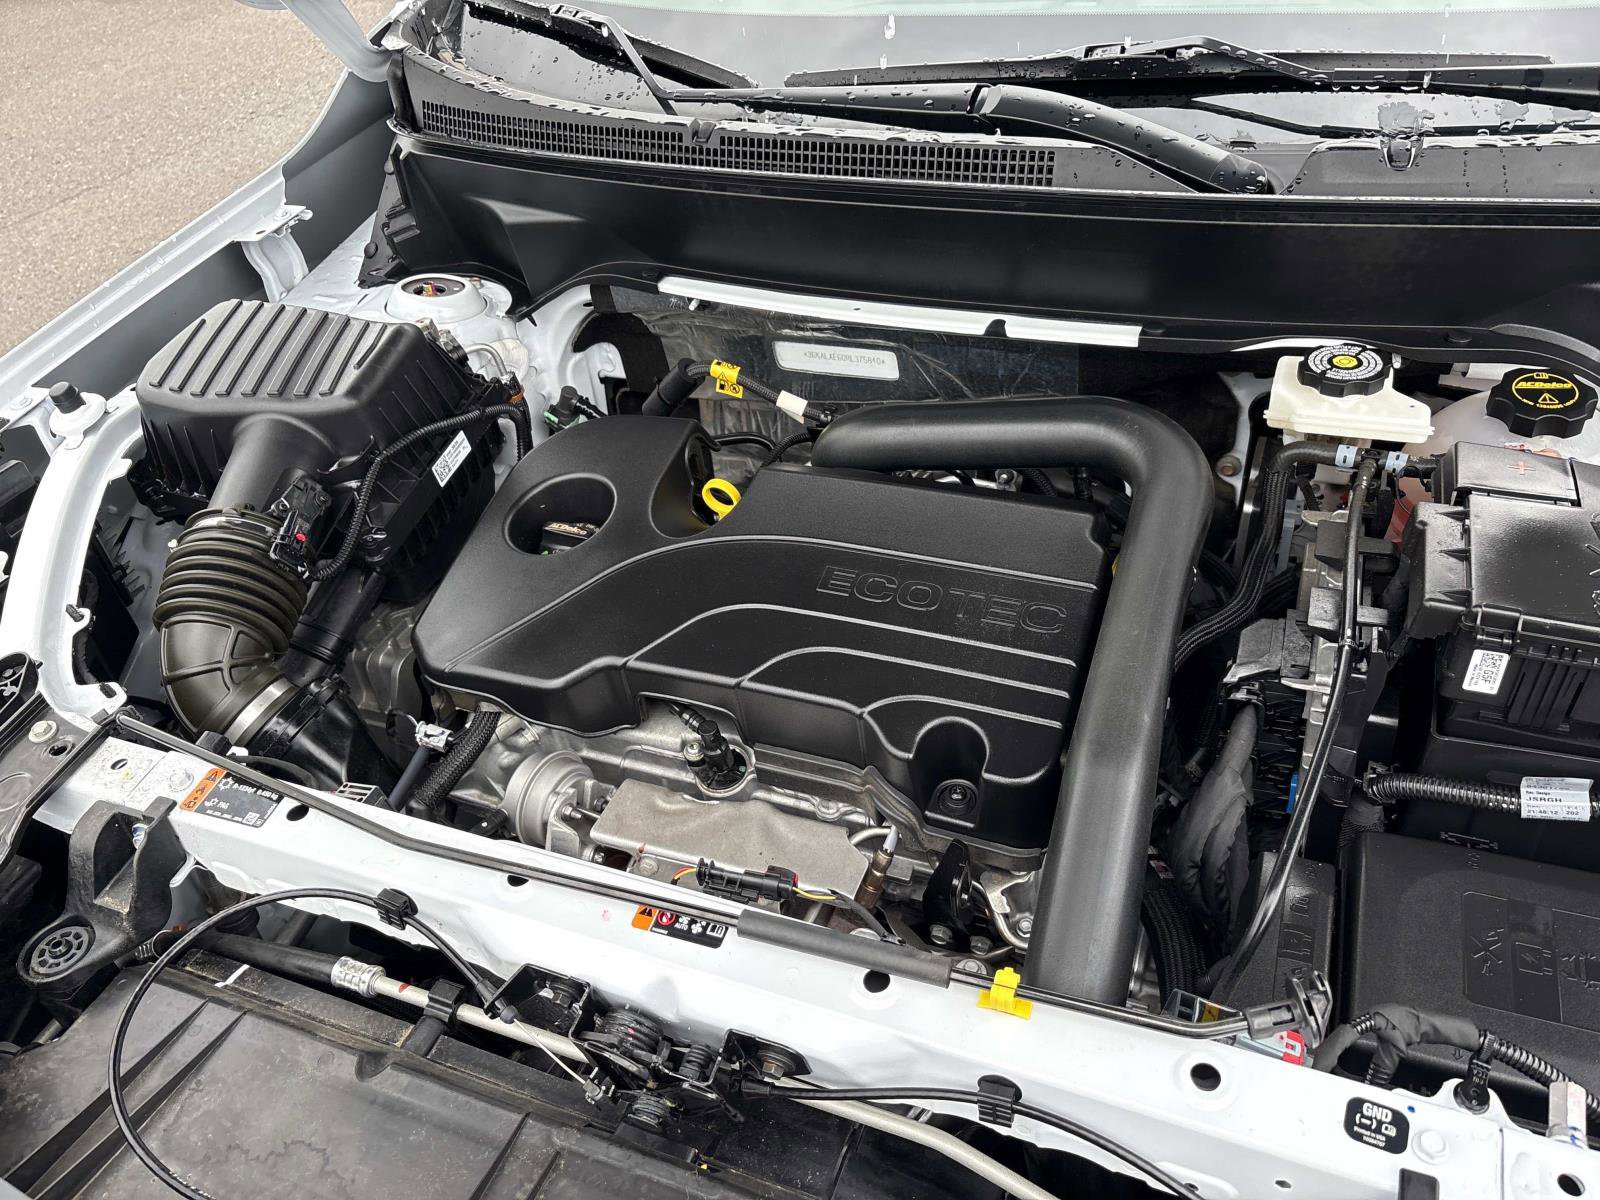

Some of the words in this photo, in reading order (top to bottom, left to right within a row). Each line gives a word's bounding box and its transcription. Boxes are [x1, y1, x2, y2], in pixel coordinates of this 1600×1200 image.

[1515, 381, 1573, 390] ACDelco
[548, 522, 588, 536] ACDelco
[816, 565, 1068, 634] ECOTEC
[673, 922, 689, 931] AUTO
[1362, 1102, 1393, 1123] GND
